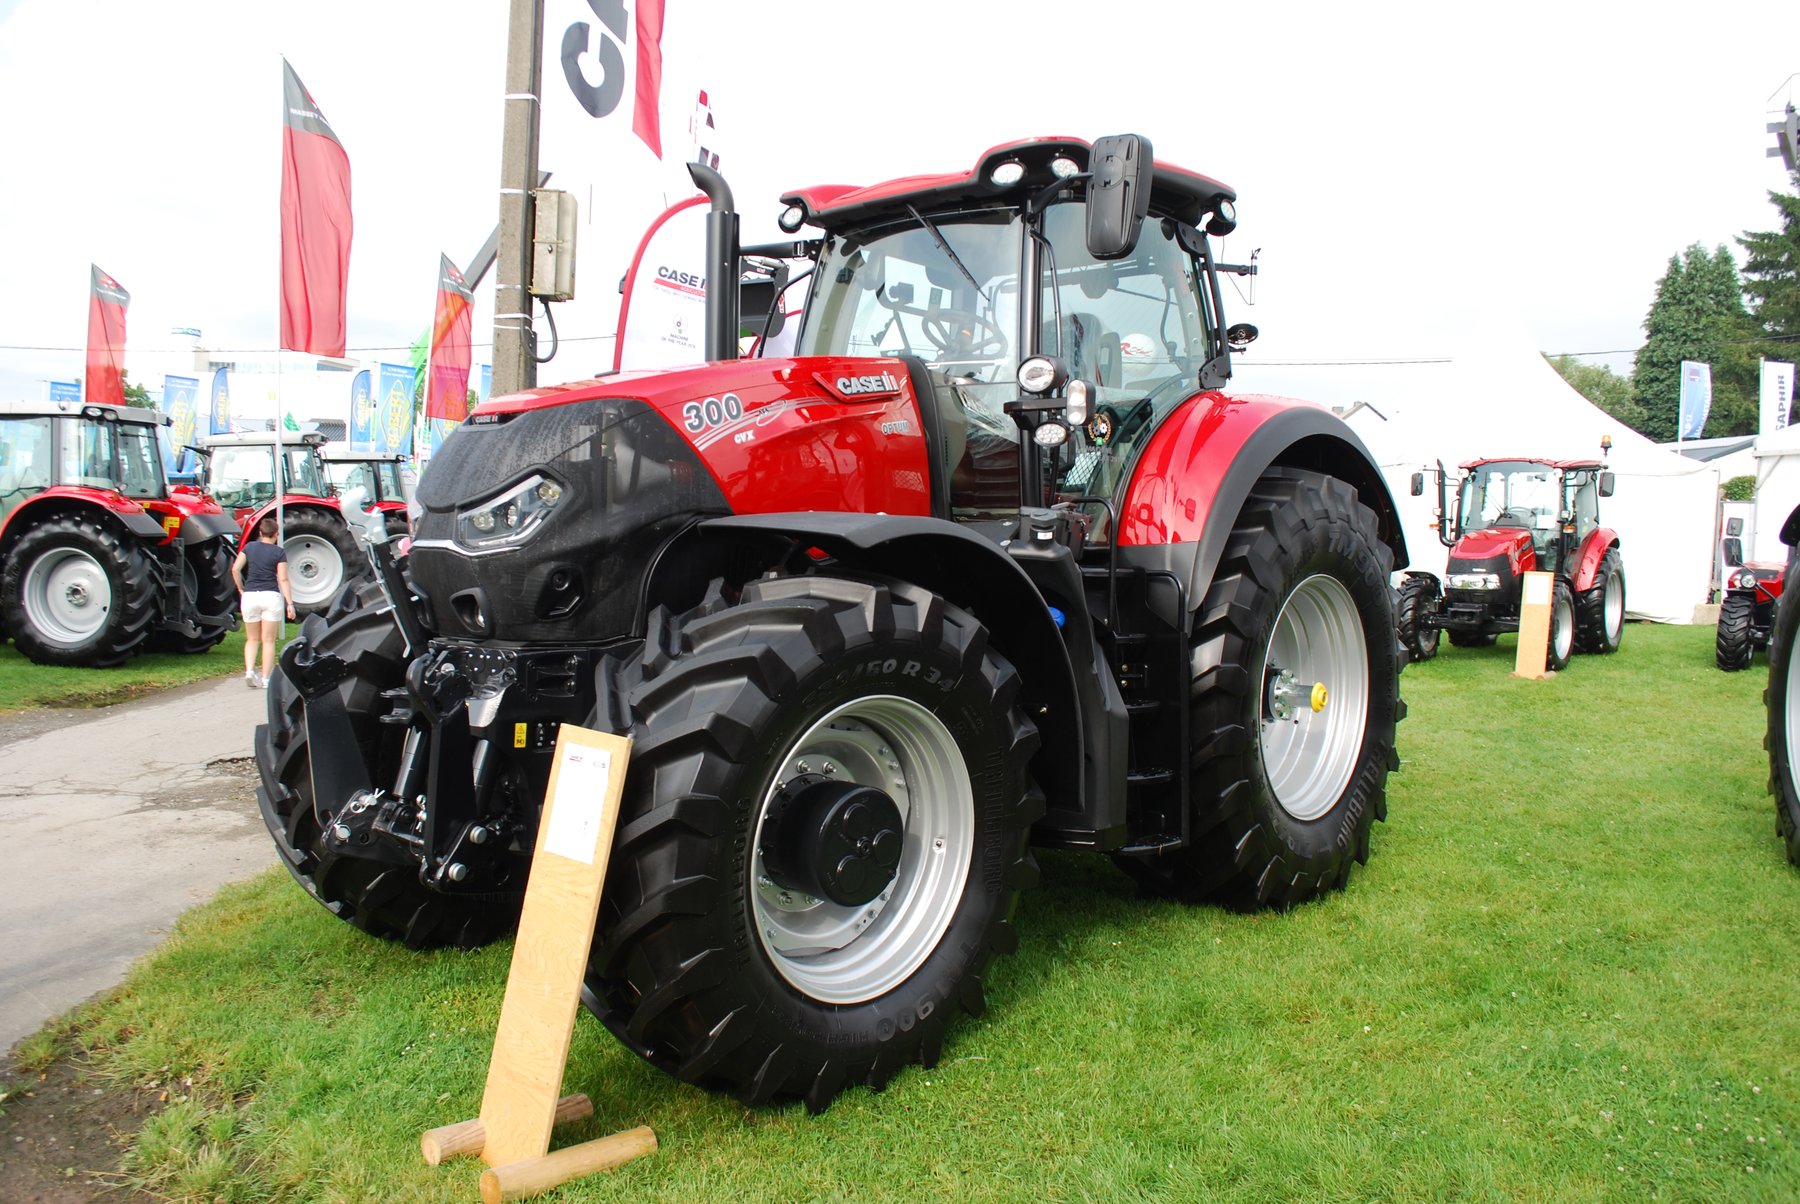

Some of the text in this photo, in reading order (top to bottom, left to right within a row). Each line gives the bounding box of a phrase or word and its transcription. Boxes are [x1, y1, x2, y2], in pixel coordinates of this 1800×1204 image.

[657, 265, 699, 288] CASE
[837, 374, 884, 395] CASE
[386, 390, 406, 447] ROBERT
[682, 393, 743, 433] 300
[881, 419, 909, 435] OPTUM
